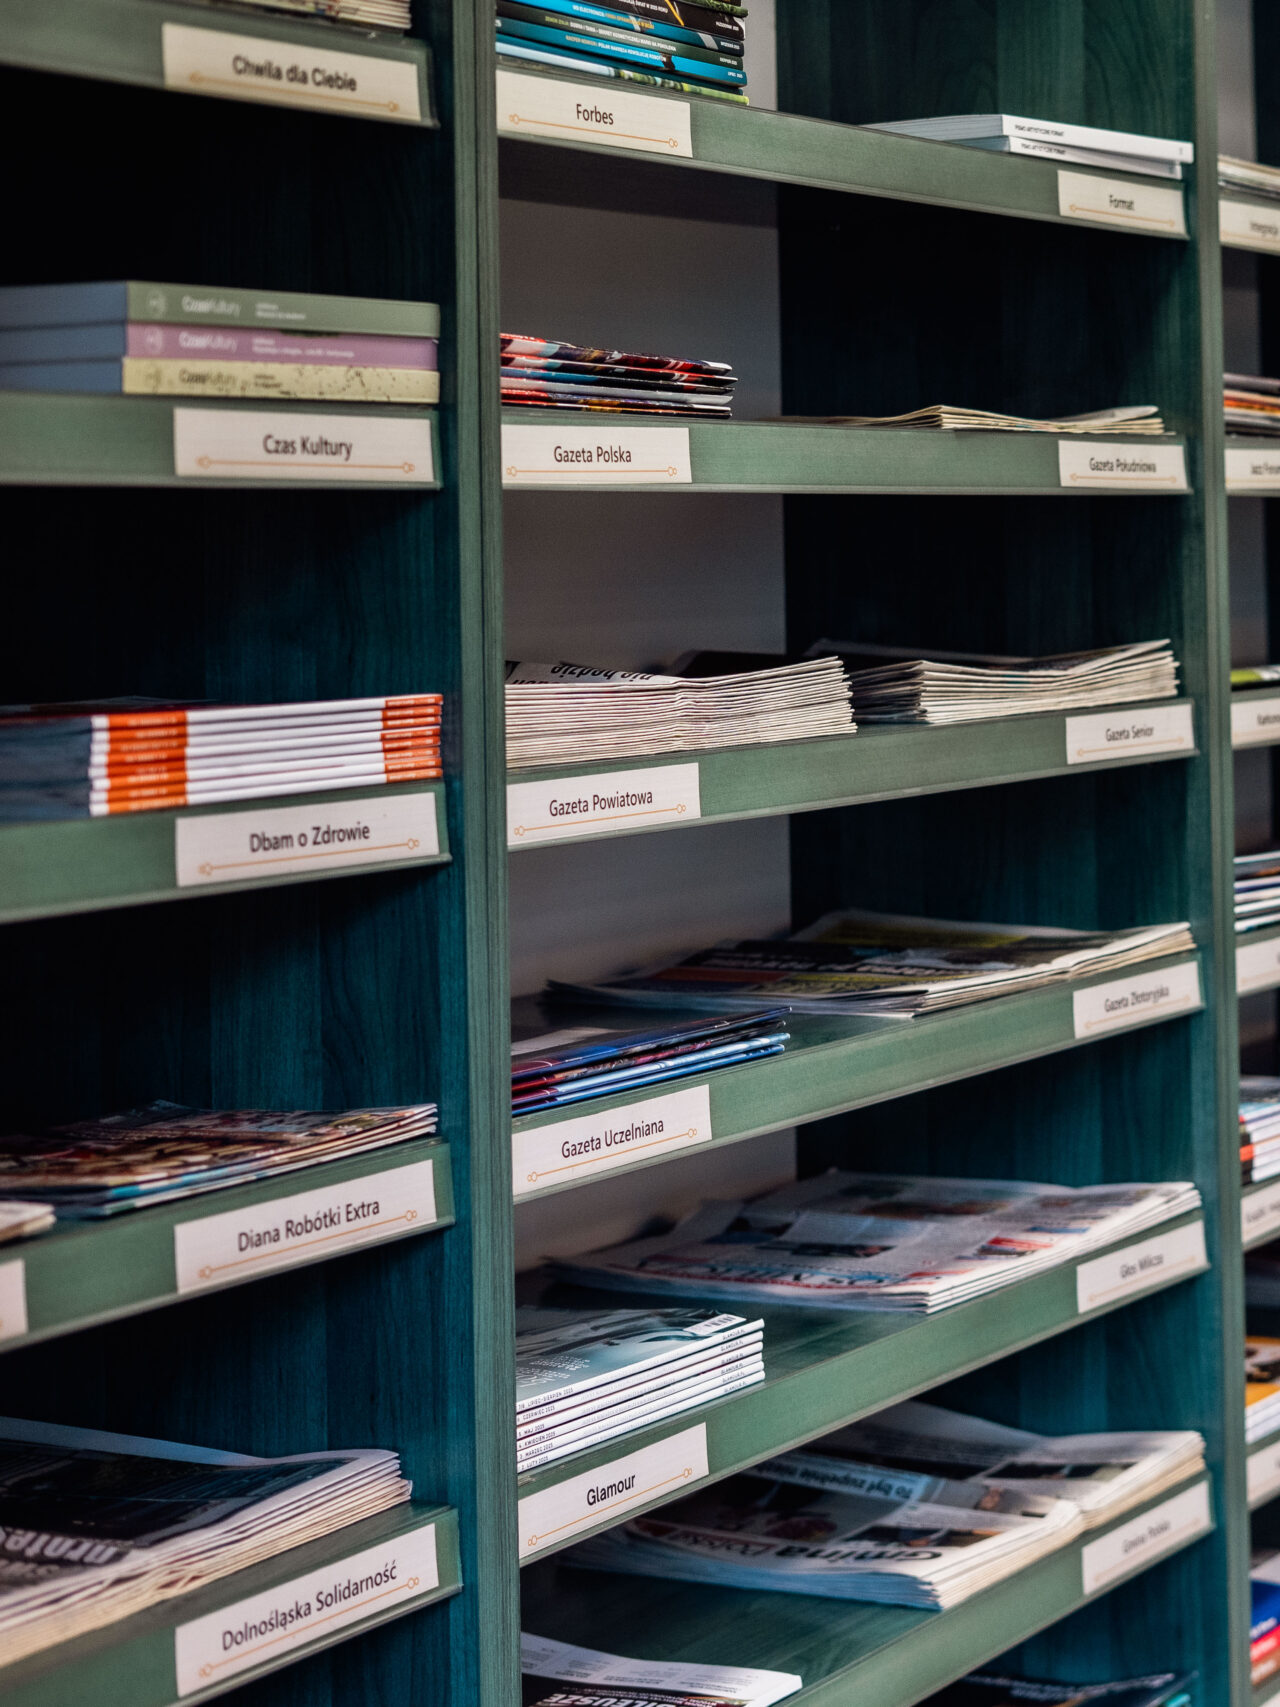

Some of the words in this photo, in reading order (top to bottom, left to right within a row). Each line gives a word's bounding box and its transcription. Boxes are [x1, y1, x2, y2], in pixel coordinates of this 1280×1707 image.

[233, 55, 282, 81] Chwila
[286, 63, 307, 84] dla
[311, 68, 356, 91] Ciebie
[576, 104, 614, 125] Forbes
[1109, 194, 1133, 210] Format
[263, 434, 296, 456] Czas
[301, 436, 352, 460] Kultury
[554, 446, 592, 462] Gazeta
[597, 446, 631, 462] Polska
[1089, 458, 1113, 471] Gazeta
[1106, 728, 1129, 741] Gazeta
[1132, 725, 1153, 739] Senior
[549, 798, 588, 817] Gazeta
[593, 791, 653, 811] Powiatowa
[250, 831, 293, 853] Dbam
[298, 833, 308, 846] o
[312, 823, 370, 846] Zdrowie
[1104, 998, 1129, 1012] Gazeta
[561, 1138, 601, 1158] Gazeta
[605, 1118, 664, 1147] Uczelniana
[238, 1226, 280, 1253] Diana
[285, 1207, 342, 1239] Robótki
[346, 1199, 380, 1223] Extra
[587, 1474, 635, 1506] Glamour
[775, 1546, 942, 1563] Gmina
[222, 1599, 312, 1650] Dolnośląska
[316, 1560, 398, 1611] Solidarność
